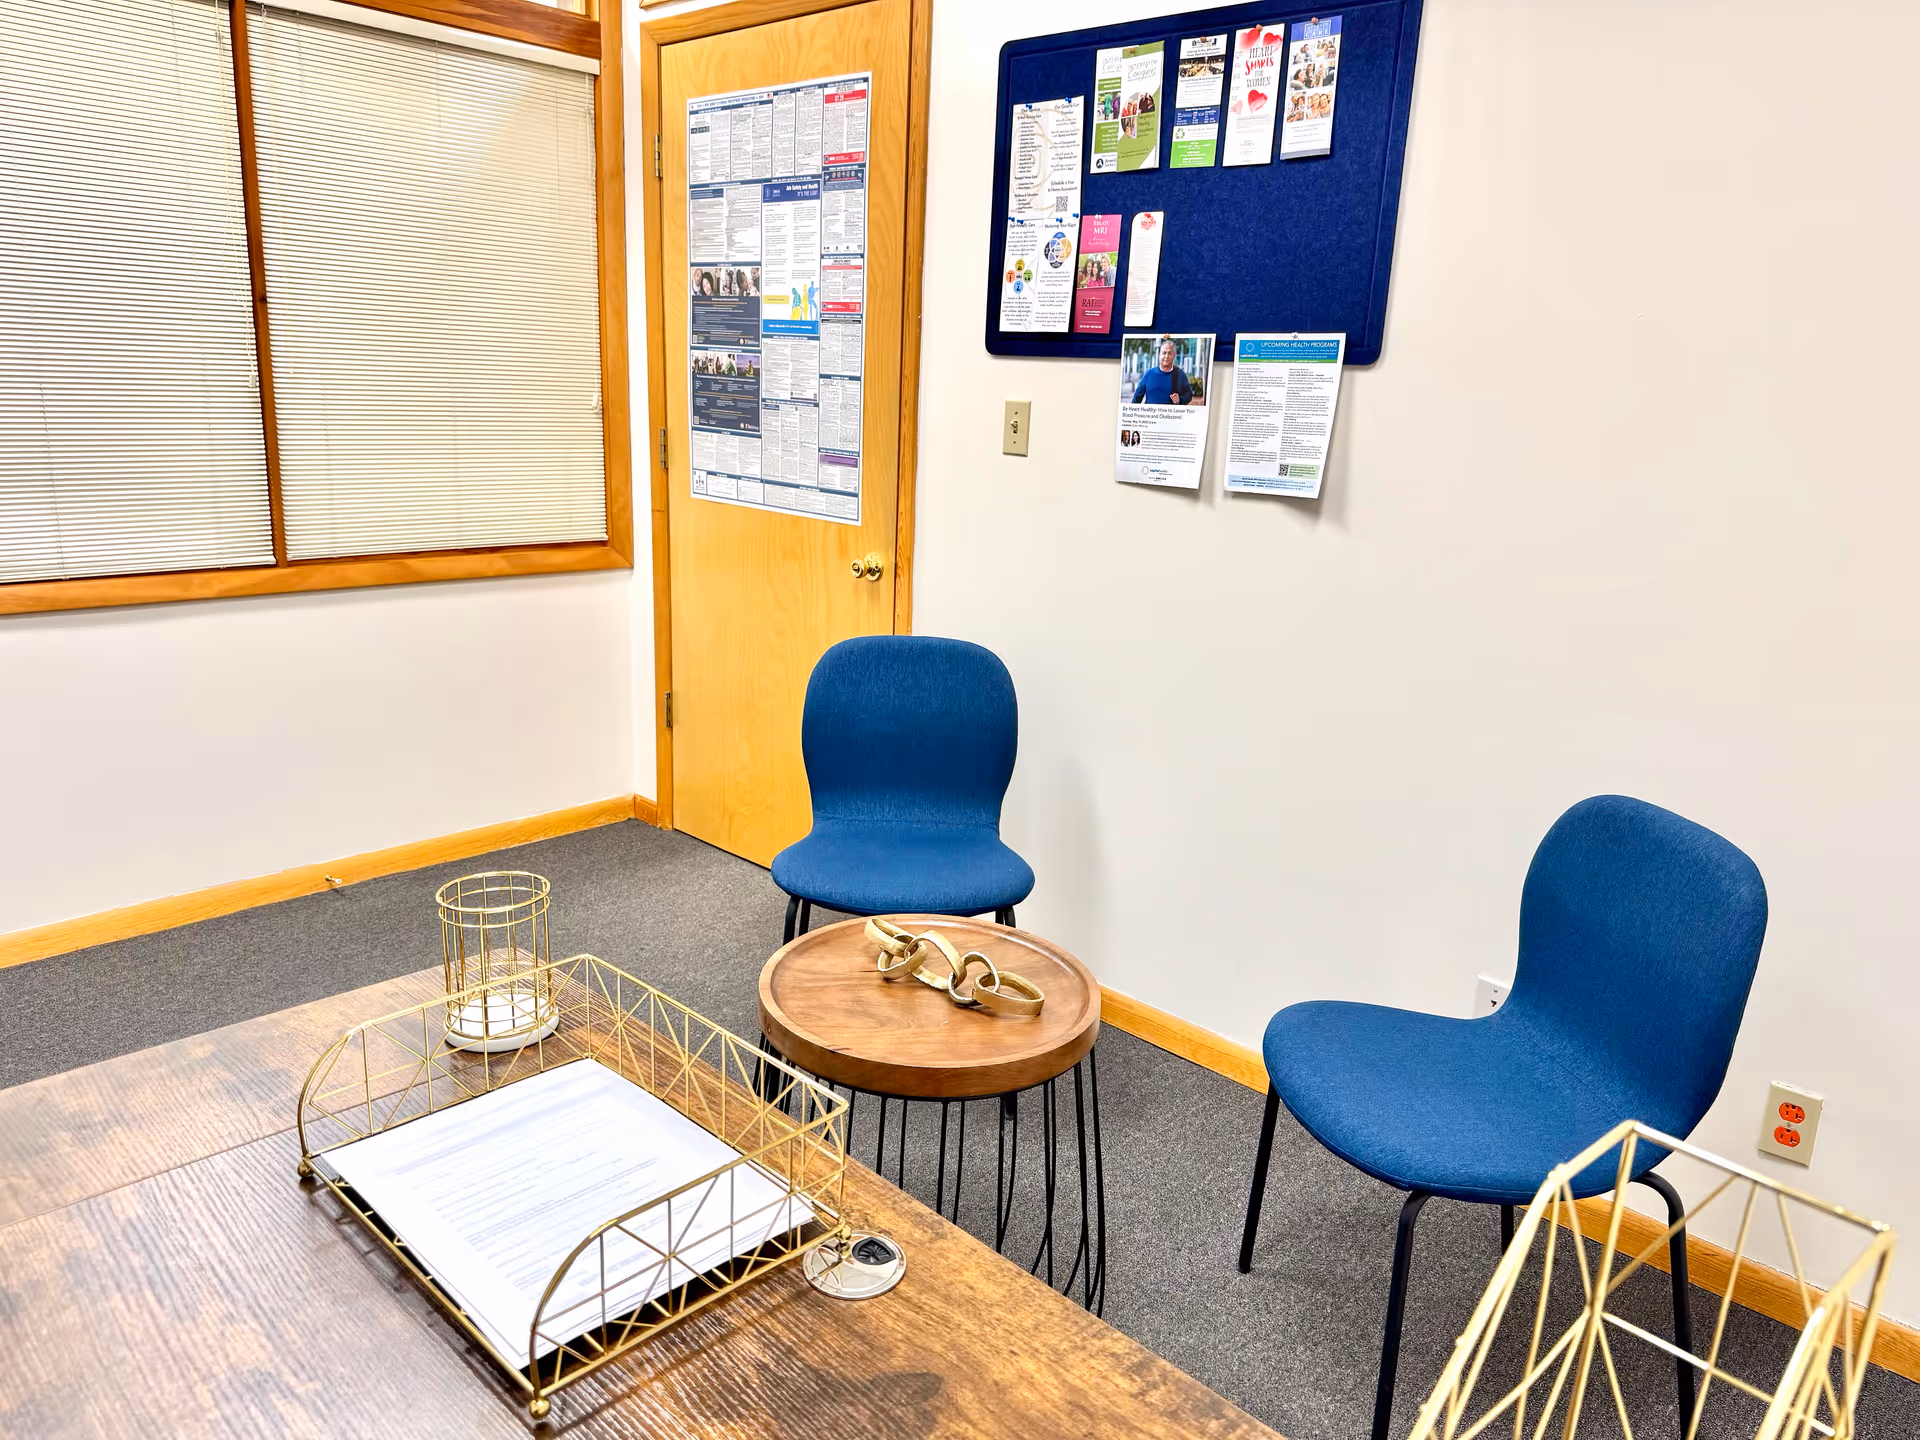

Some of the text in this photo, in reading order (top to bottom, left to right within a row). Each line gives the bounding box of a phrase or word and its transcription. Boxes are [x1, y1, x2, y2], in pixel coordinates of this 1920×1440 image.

[1305, 28, 1329, 39] CARE
[1249, 45, 1274, 58] HEART
[1245, 57, 1274, 75] SMARTS
[1247, 77, 1271, 87] WOMEN
[1093, 226, 1107, 234] MRI
